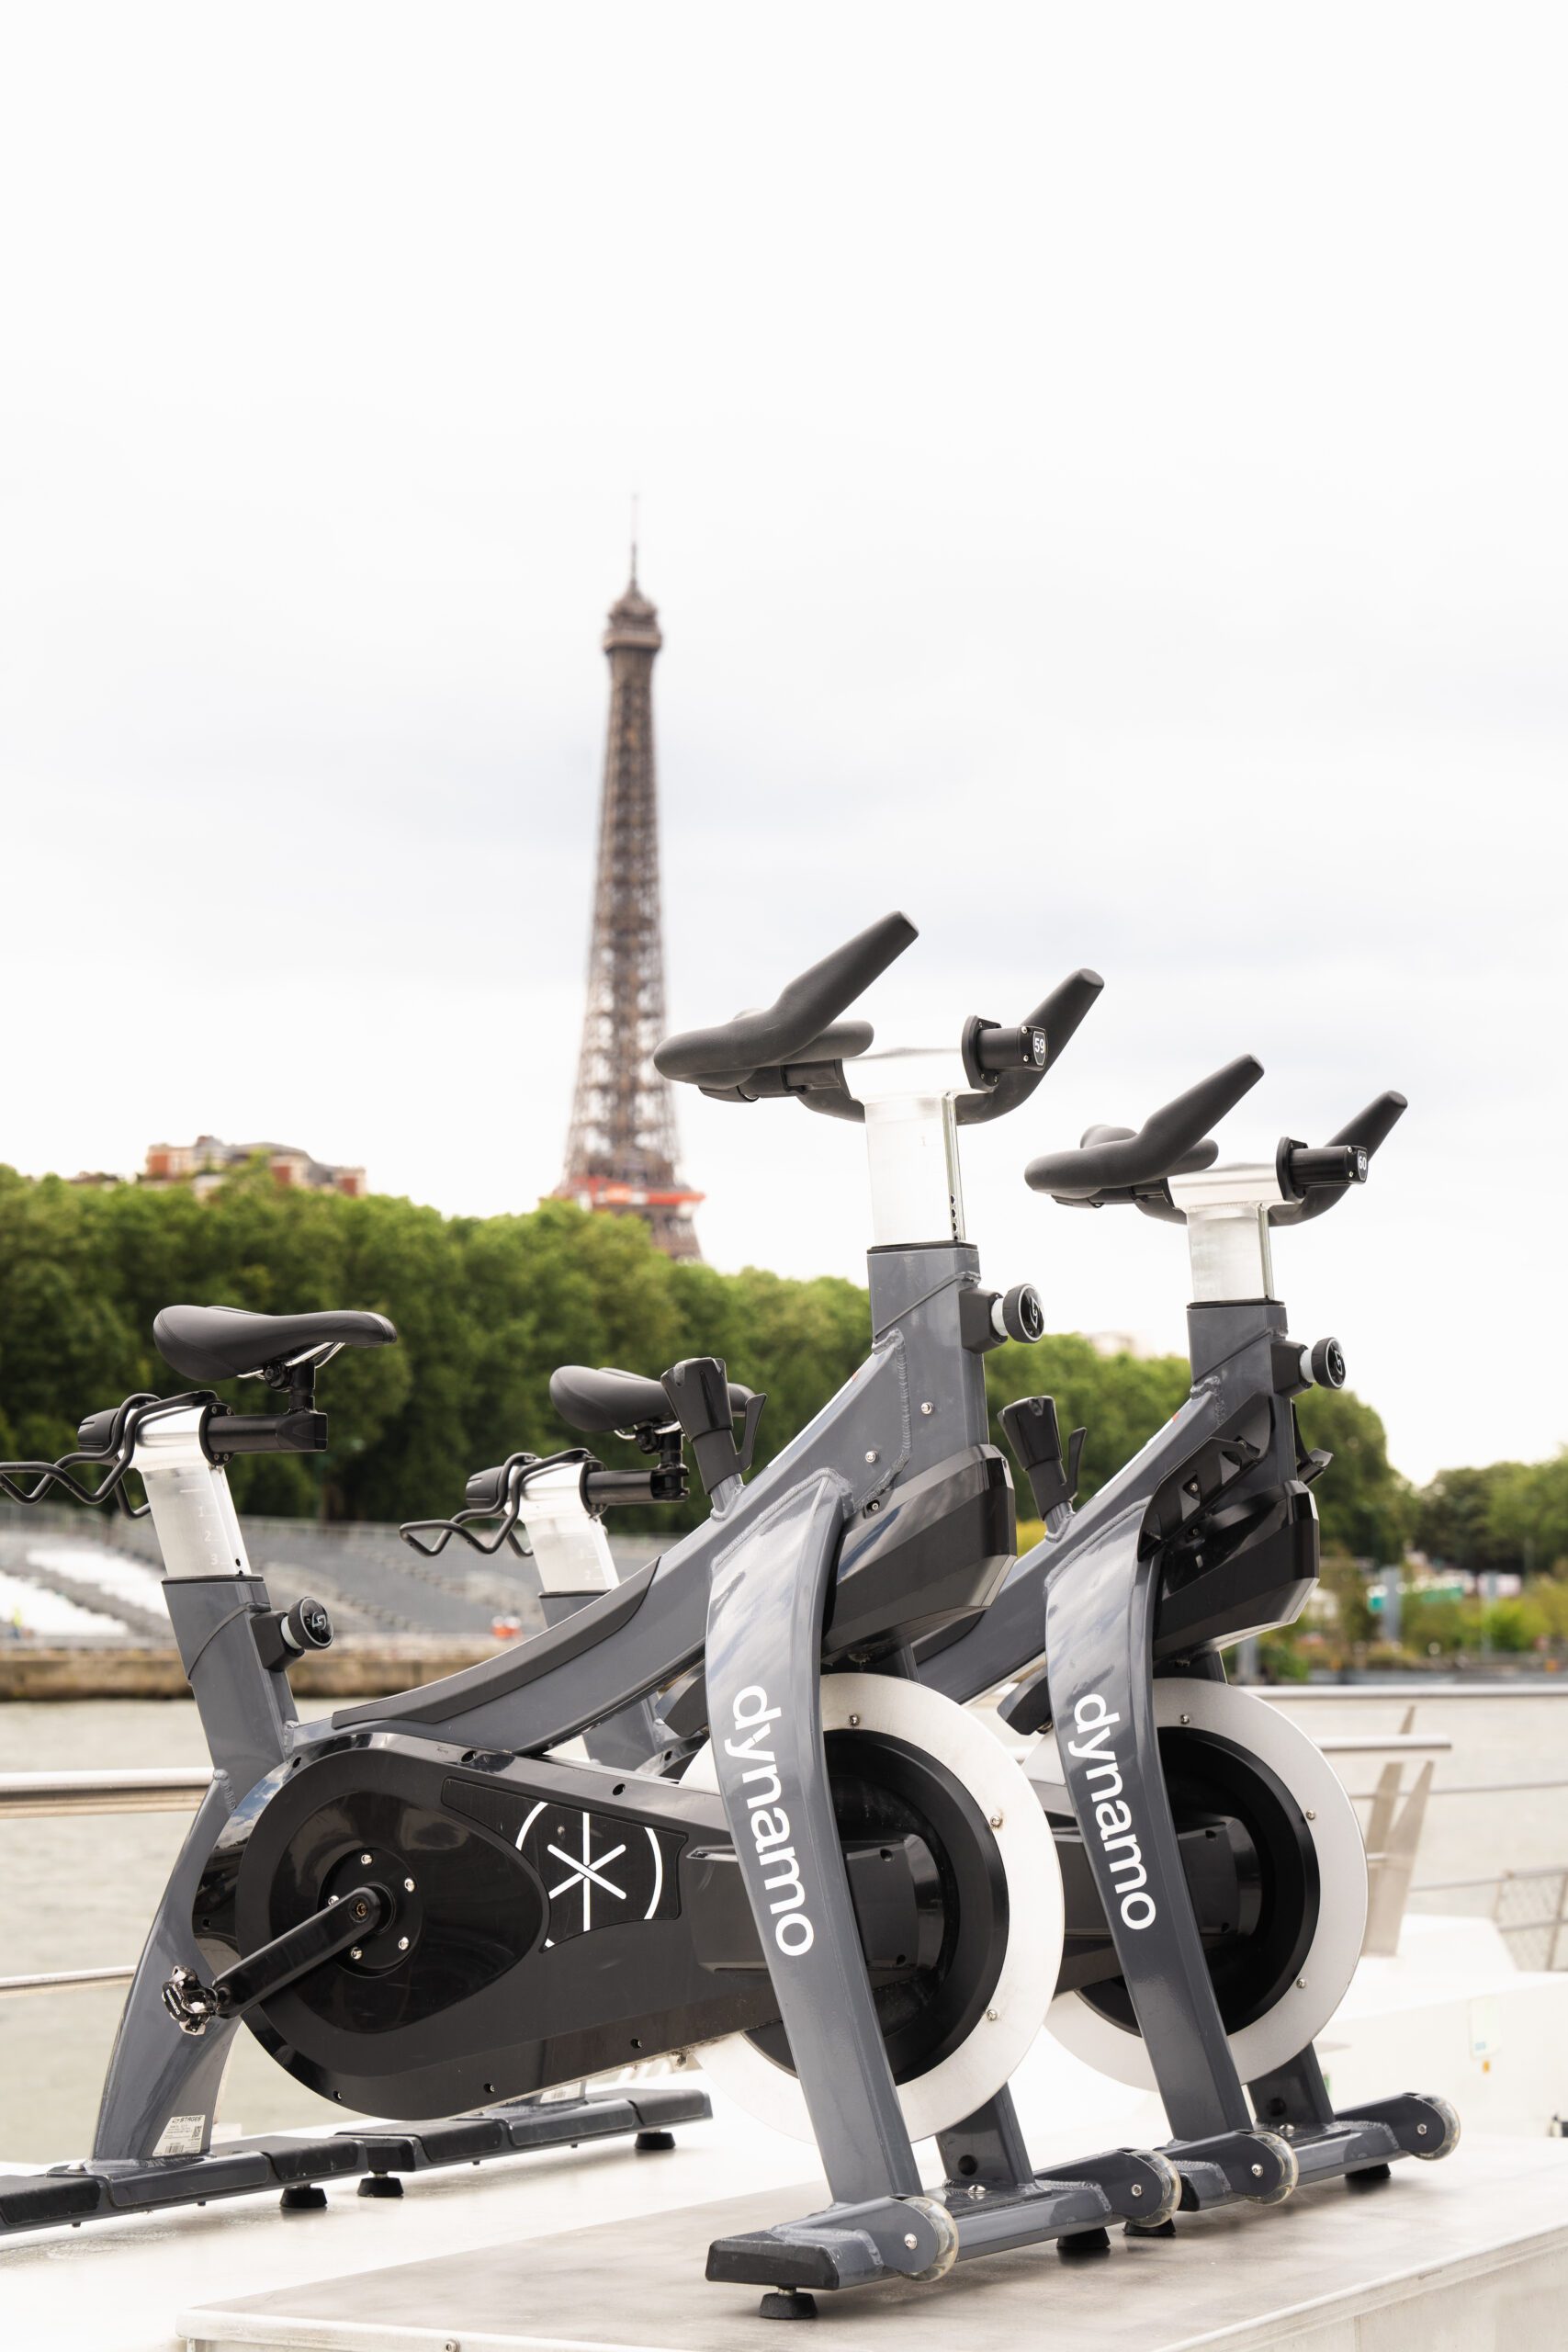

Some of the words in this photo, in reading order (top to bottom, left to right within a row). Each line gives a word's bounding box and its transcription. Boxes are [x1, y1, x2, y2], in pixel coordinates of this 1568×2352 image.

[1034, 1037, 1044, 1054] 59
[1359, 1156, 1367, 1170] 60
[204, 1530, 212, 1542] 2
[210, 1554, 220, 1566] 3
[1068, 1693, 1156, 1929] dynamo
[724, 1685, 815, 1956] dynamo
